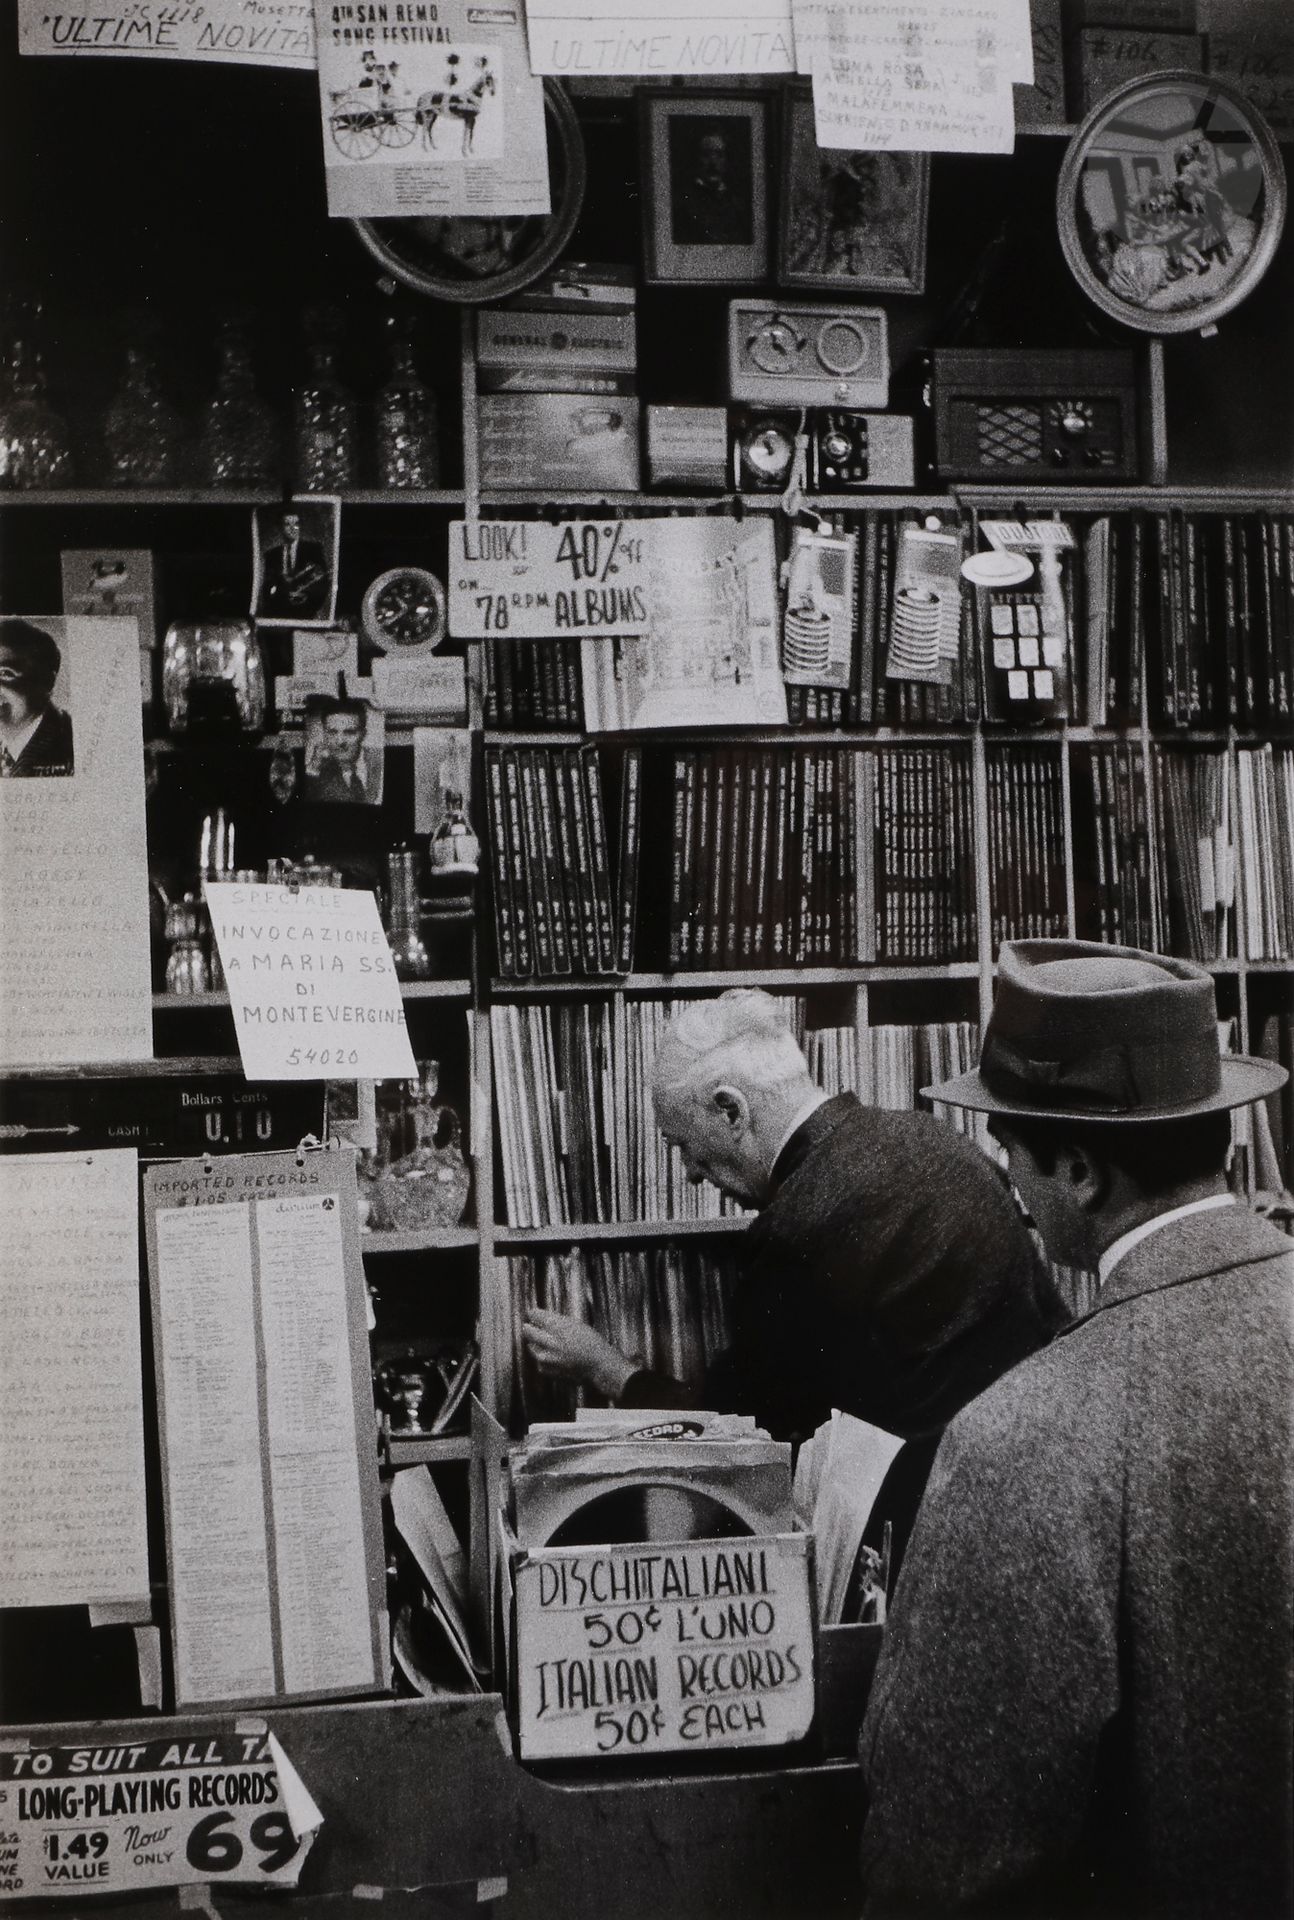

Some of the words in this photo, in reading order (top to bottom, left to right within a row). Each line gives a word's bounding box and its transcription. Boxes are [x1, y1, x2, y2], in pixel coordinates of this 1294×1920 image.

[358, 4, 388, 22] SAN
[397, 3, 438, 21] REMO
[332, 28, 375, 46] SONG
[383, 26, 451, 45] FESTIVAL
[552, 30, 672, 70] ULTIME
[462, 523, 528, 562] LOOK!
[555, 521, 623, 584] 40%
[475, 594, 508, 631] 78
[554, 585, 648, 629] ALBUMS
[231, 889, 344, 909] SPECIALE
[221, 925, 381, 945] INVOCAZIONE
[228, 956, 241, 970] A
[252, 953, 345, 973] MARIA
[359, 956, 393, 974] SS.
[296, 982, 316, 996] DI
[243, 1005, 406, 1025] MONTEVERGINE
[286, 1047, 359, 1066] 54020
[181, 1092, 223, 1106] Dollars
[153, 1176, 235, 1194] IMPORTED
[244, 1172, 320, 1188] RECORDS
[583, 1605, 662, 1649] 50¢
[677, 1600, 775, 1643] L'UNO
[535, 1655, 658, 1719] ITALIAN
[678, 1645, 802, 1700] RECORDS
[594, 1703, 666, 1751] 50¢
[679, 1701, 767, 1741] EACH
[12, 1753, 52, 1776] TO
[68, 1747, 147, 1773] SUIT
[160, 1740, 223, 1767] ALL
[18, 1777, 182, 1821] LONG-PLAYING
[188, 1771, 279, 1808] RECORDS
[123, 1825, 173, 1853] Now
[185, 1811, 301, 1874] 69
[132, 1851, 174, 1867] ONLY
[44, 1861, 110, 1881] VALUE
